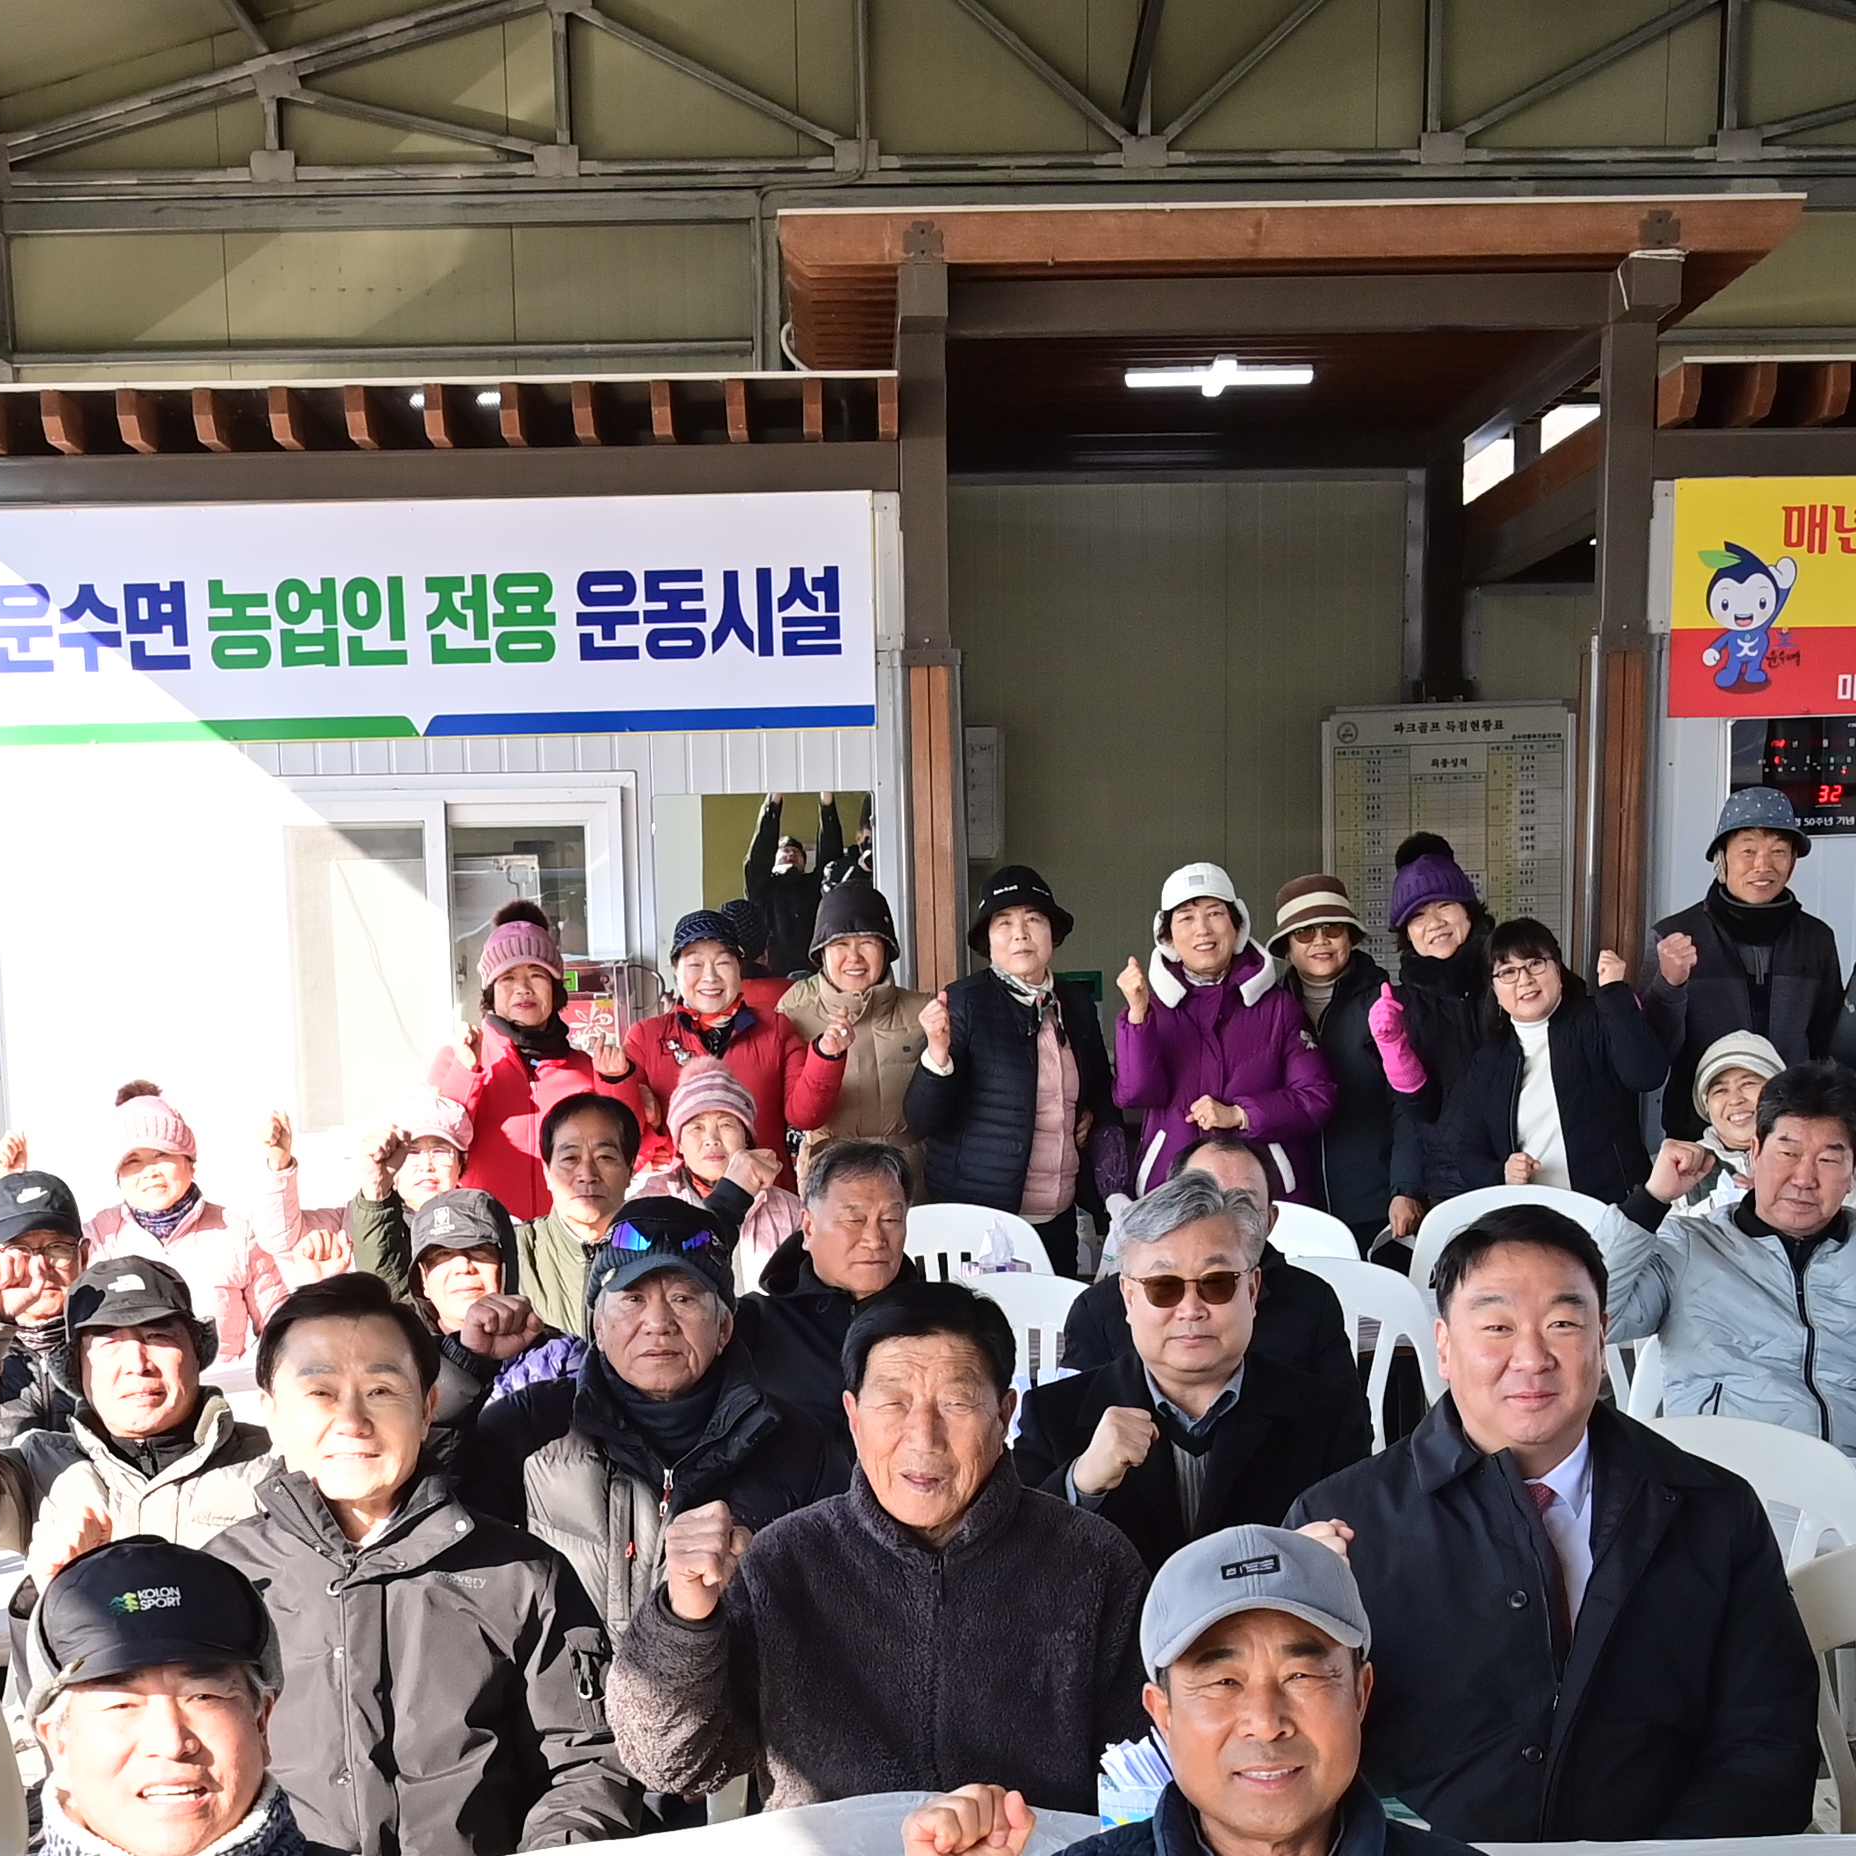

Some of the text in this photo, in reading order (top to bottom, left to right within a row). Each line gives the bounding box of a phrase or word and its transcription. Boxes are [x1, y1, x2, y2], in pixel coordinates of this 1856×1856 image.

[207, 576, 408, 670] 농업인
[425, 571, 557, 665] 전용
[575, 565, 843, 662] 운동시설
[1393, 719, 1505, 735] 파크골프 득점현황표
[1818, 784, 1843, 803] 32
[1803, 816, 1834, 827] 50주년
[1836, 815, 1855, 826] 기념
[137, 1586, 181, 1600] KOLON
[140, 1597, 181, 1611] SPORT
